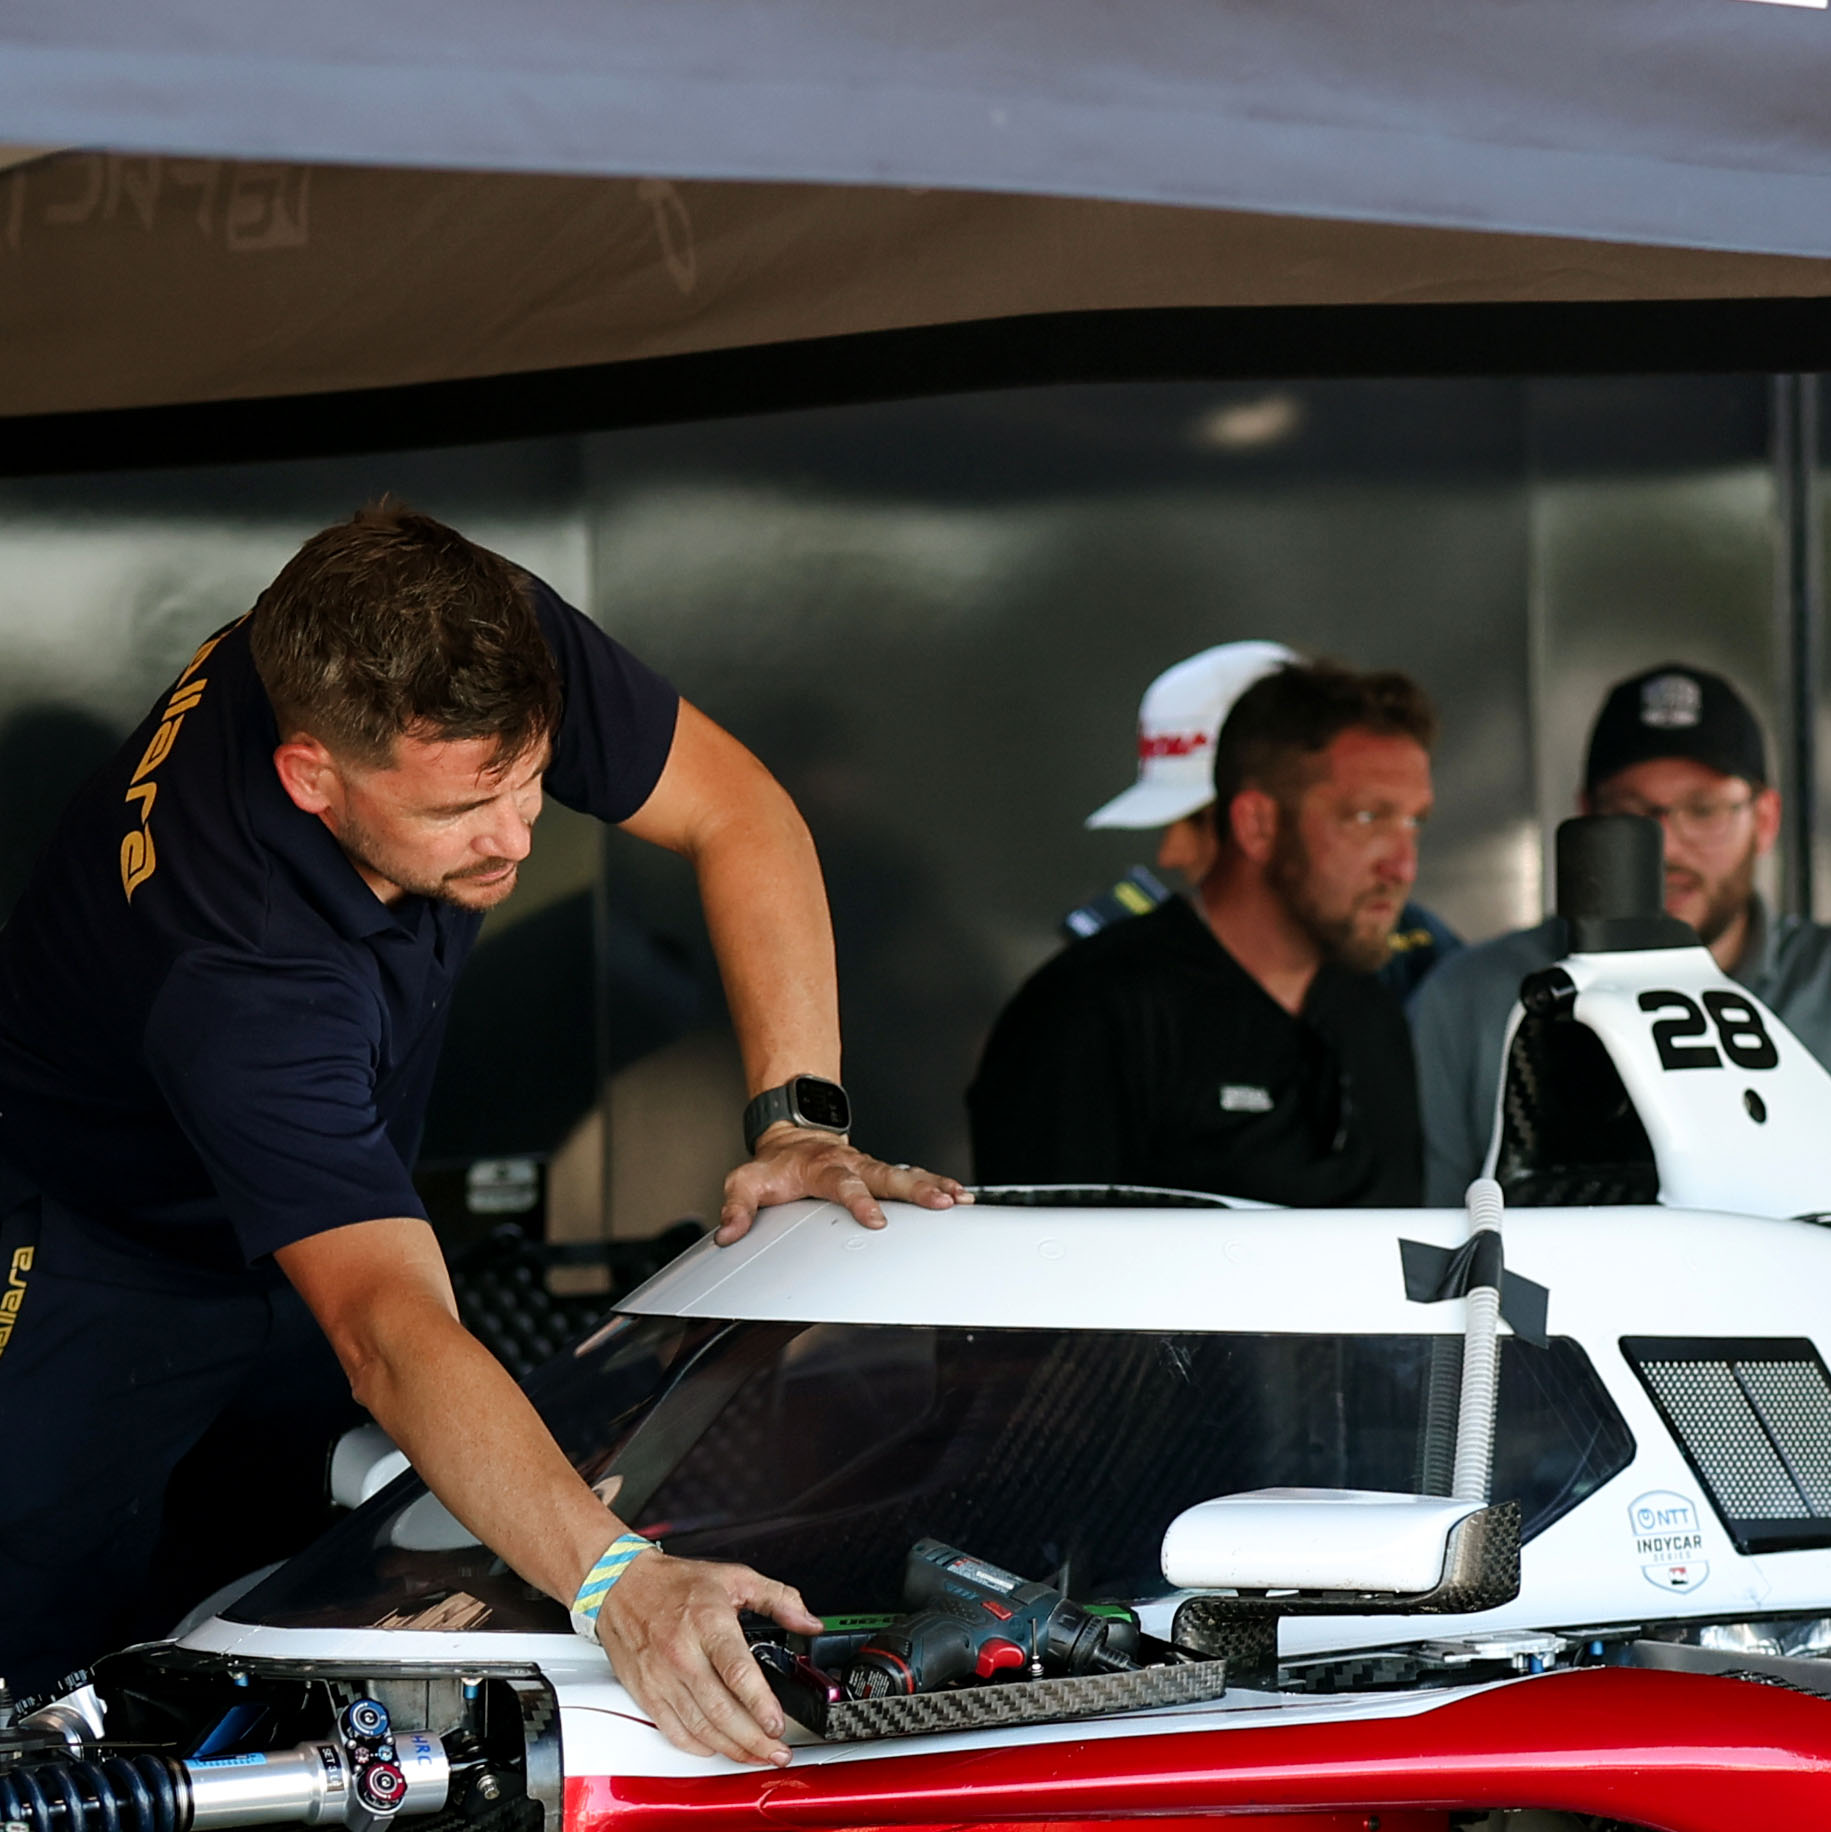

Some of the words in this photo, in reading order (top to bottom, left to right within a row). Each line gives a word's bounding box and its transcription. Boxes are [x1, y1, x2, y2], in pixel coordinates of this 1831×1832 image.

[1637, 989, 1780, 1071] 28
[1657, 1508, 1689, 1526] NTT
[1637, 1534, 1703, 1553] INDYCAR
[411, 1734, 433, 1767] HRC
